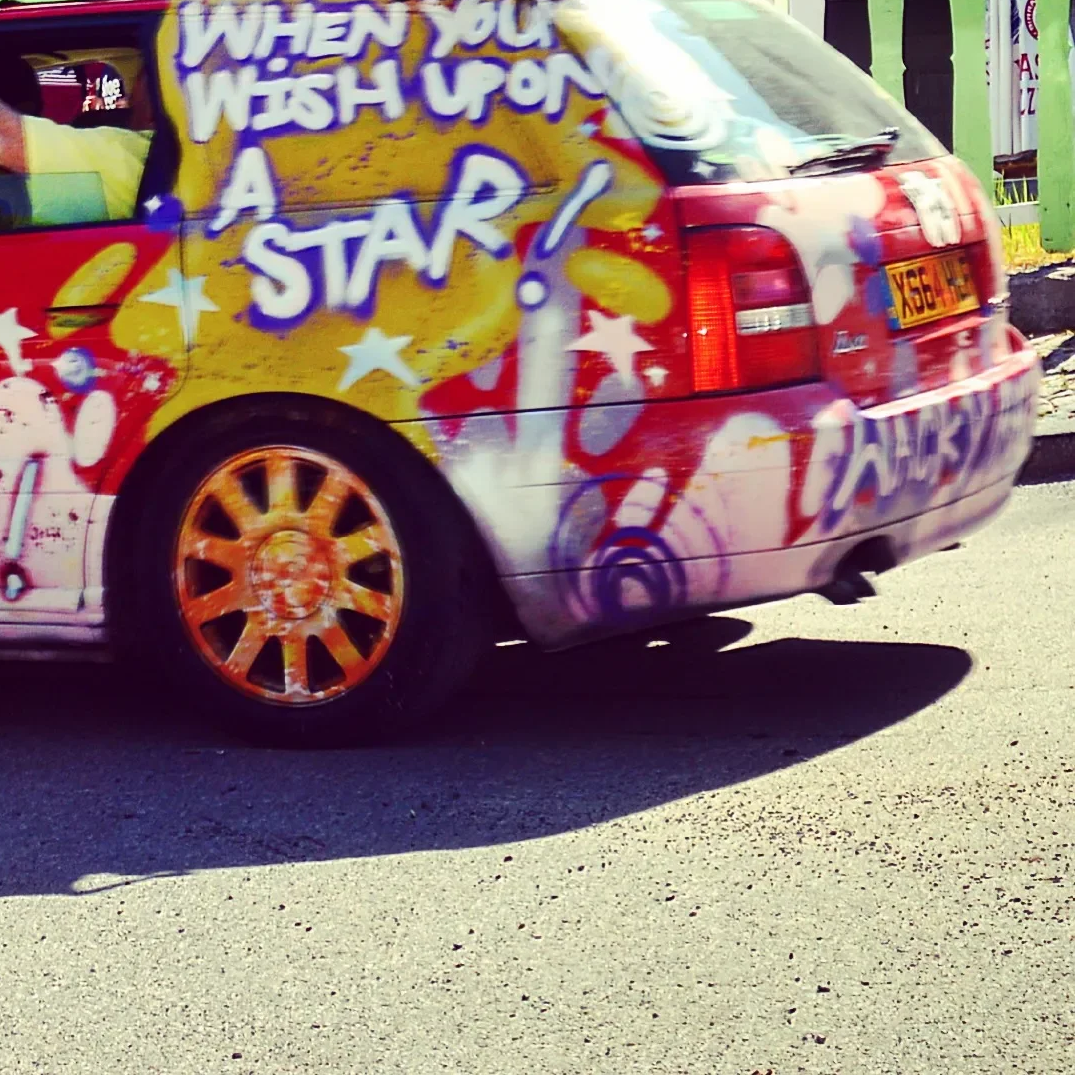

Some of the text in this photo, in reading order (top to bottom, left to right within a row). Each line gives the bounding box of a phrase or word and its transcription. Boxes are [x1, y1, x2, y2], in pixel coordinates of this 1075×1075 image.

[177, 0, 412, 68] WHEN
[181, 46, 615, 144] WISH UPON
[210, 145, 279, 234] A
